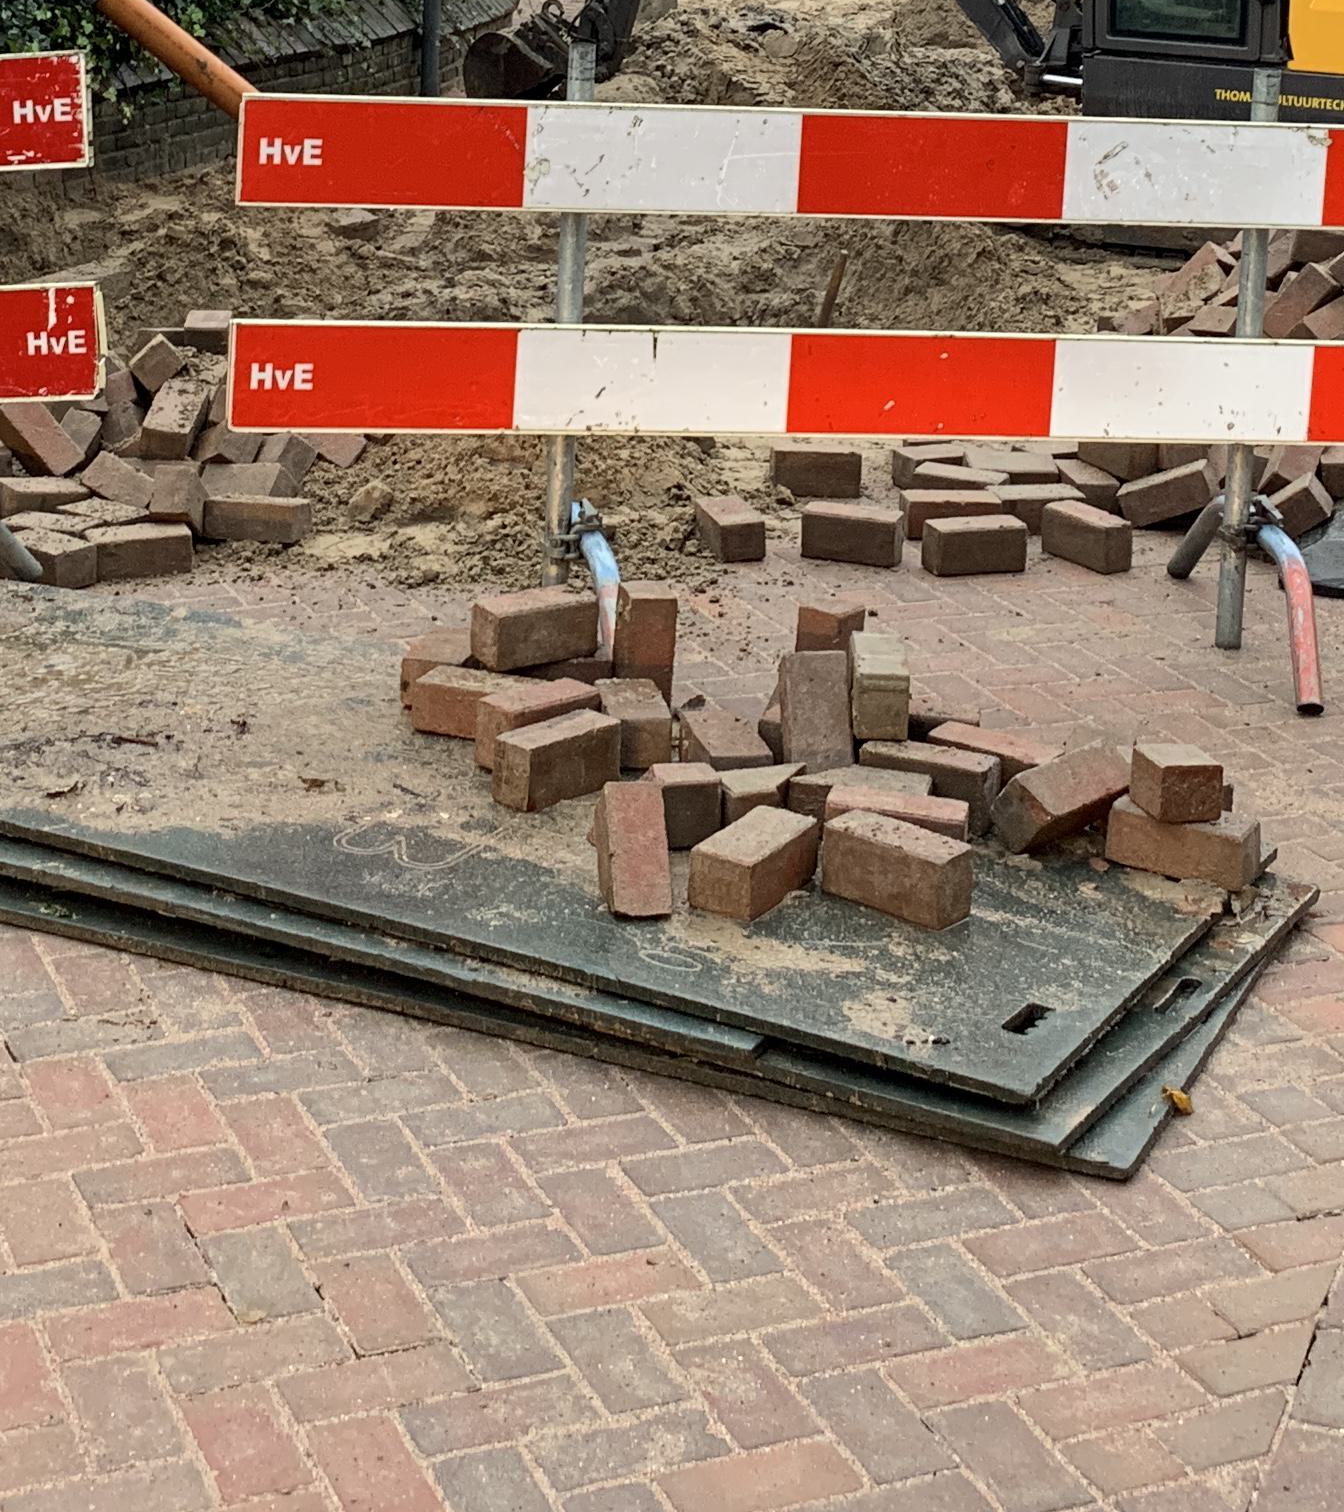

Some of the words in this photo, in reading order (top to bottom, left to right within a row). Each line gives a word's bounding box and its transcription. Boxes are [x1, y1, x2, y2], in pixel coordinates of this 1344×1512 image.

[13, 98, 73, 123] HvE
[259, 138, 323, 165] HvE
[27, 330, 87, 355] HvE
[250, 363, 314, 390] HvE
